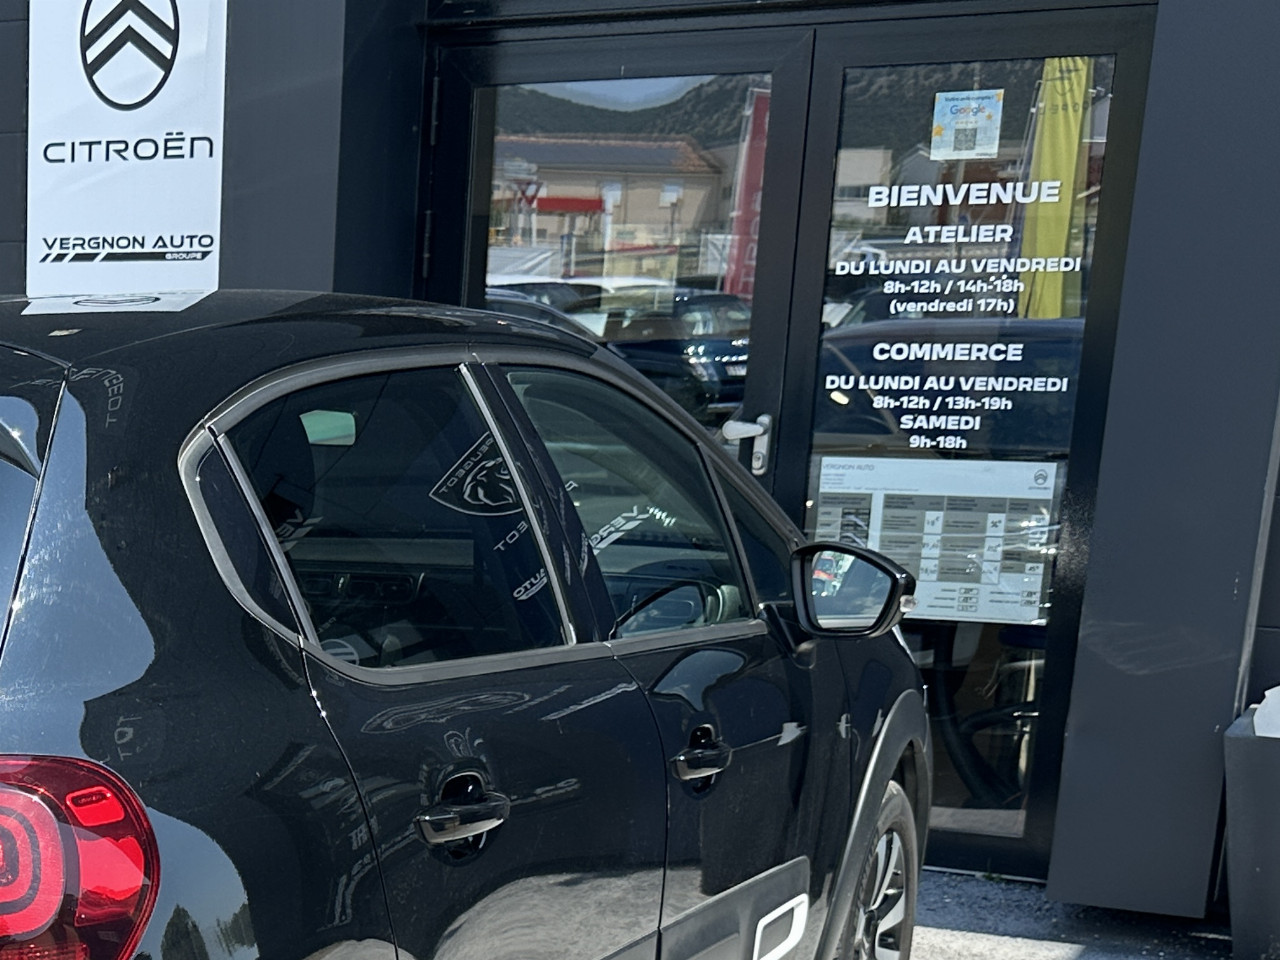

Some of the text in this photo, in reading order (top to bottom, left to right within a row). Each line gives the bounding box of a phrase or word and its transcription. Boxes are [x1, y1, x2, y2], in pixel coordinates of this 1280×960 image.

[950, 104, 985, 116] Google
[43, 132, 214, 163] CITROËN
[868, 181, 1061, 207] BIENVENUE
[904, 224, 1013, 244] ATELIER
[42, 235, 214, 250] VERGNON AUTO
[835, 257, 1081, 276] DU LUNDI AU VENDREDI
[883, 279, 940, 294] 8h-12h
[956, 278, 1024, 293] 14h-18h
[889, 298, 1014, 314] (vendredi 17h)
[872, 343, 1024, 361] COMMERCE
[825, 375, 1068, 392] DU LUNDI AU VENDREDI
[872, 396, 930, 410] 8h-12h
[945, 397, 1012, 410] 13h-19h
[900, 415, 981, 430] SAMEDI
[909, 436, 967, 449] 9h-18h
